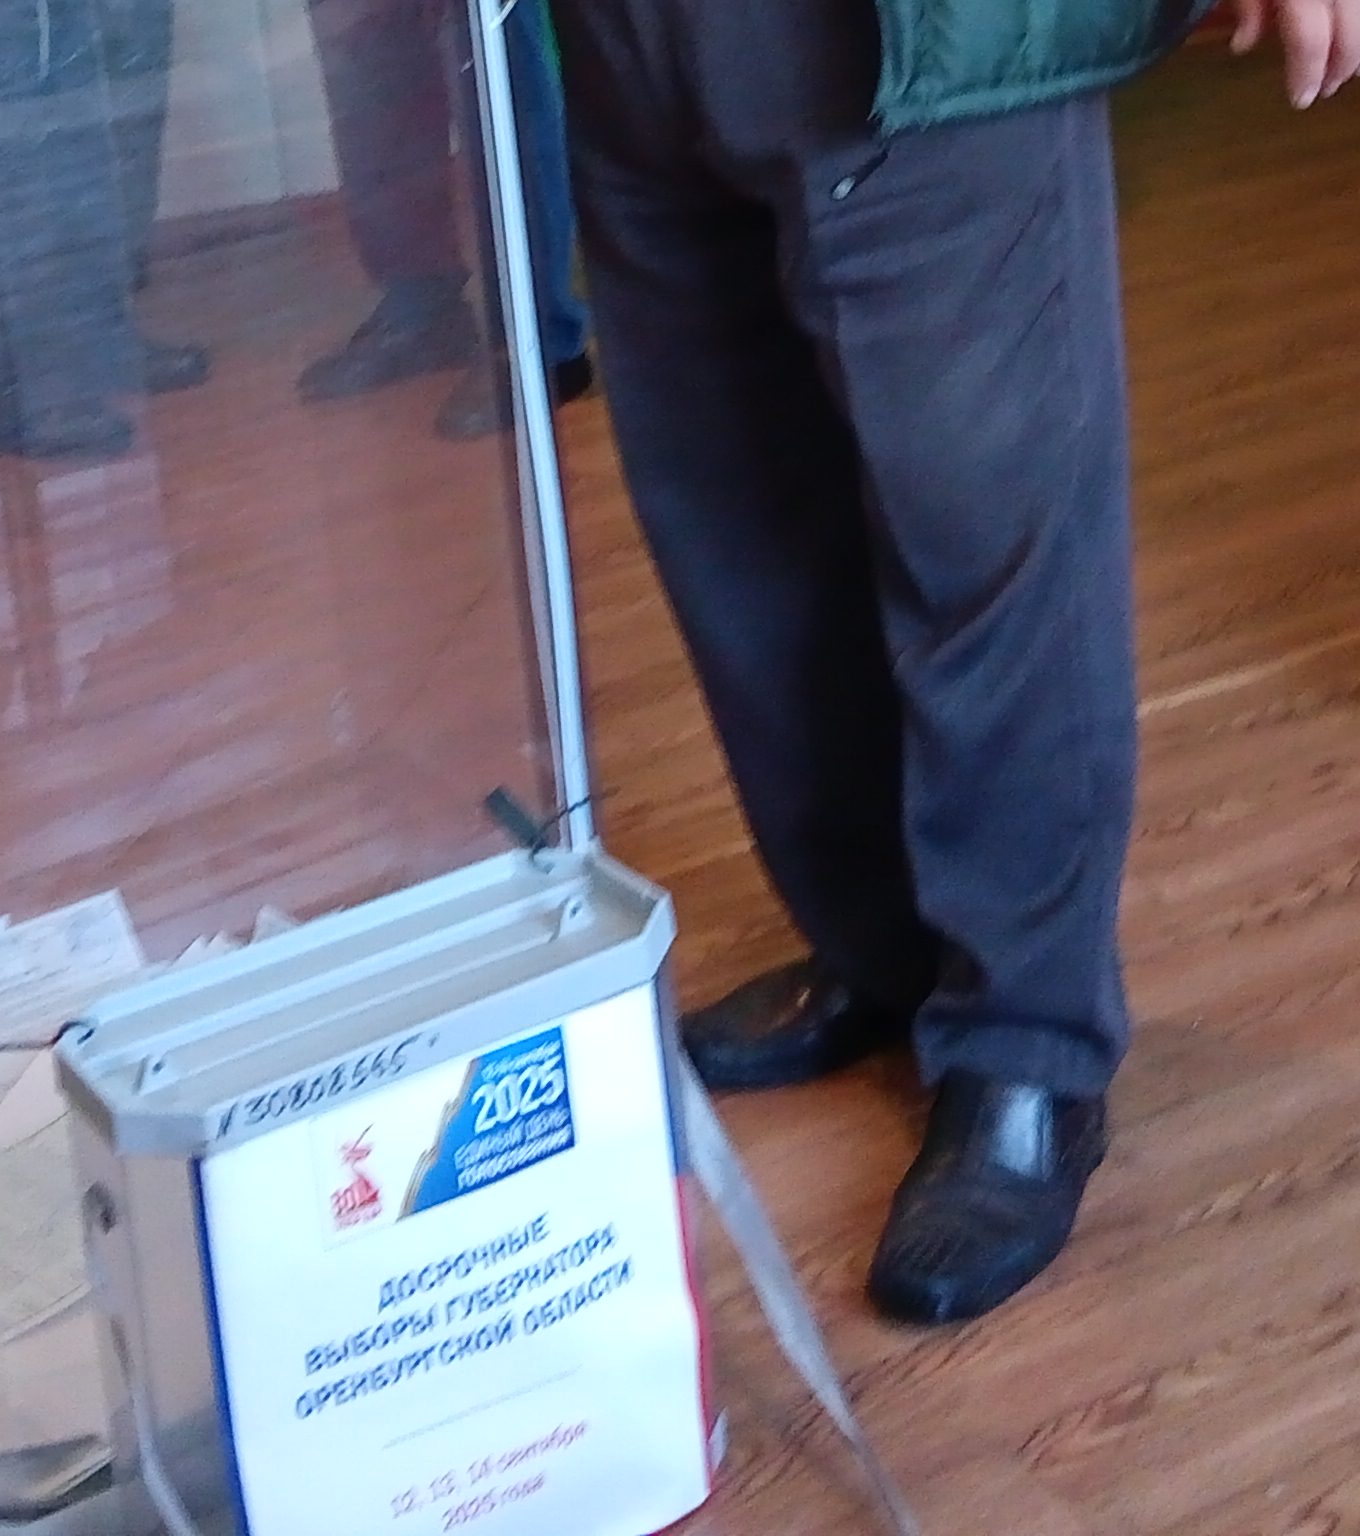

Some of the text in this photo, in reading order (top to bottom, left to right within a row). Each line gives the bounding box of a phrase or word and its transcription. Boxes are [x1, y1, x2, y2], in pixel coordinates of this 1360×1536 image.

[471, 1055, 565, 1133] 2025
[304, 1222, 618, 1376] ВЫБОРЫ ГУБЕРНАТОРА
[378, 1211, 551, 1315] ДОСРОЧНЫЕ
[294, 1255, 634, 1420] ОРЕНБУРГСКОЙ ОБЛАСТИ
